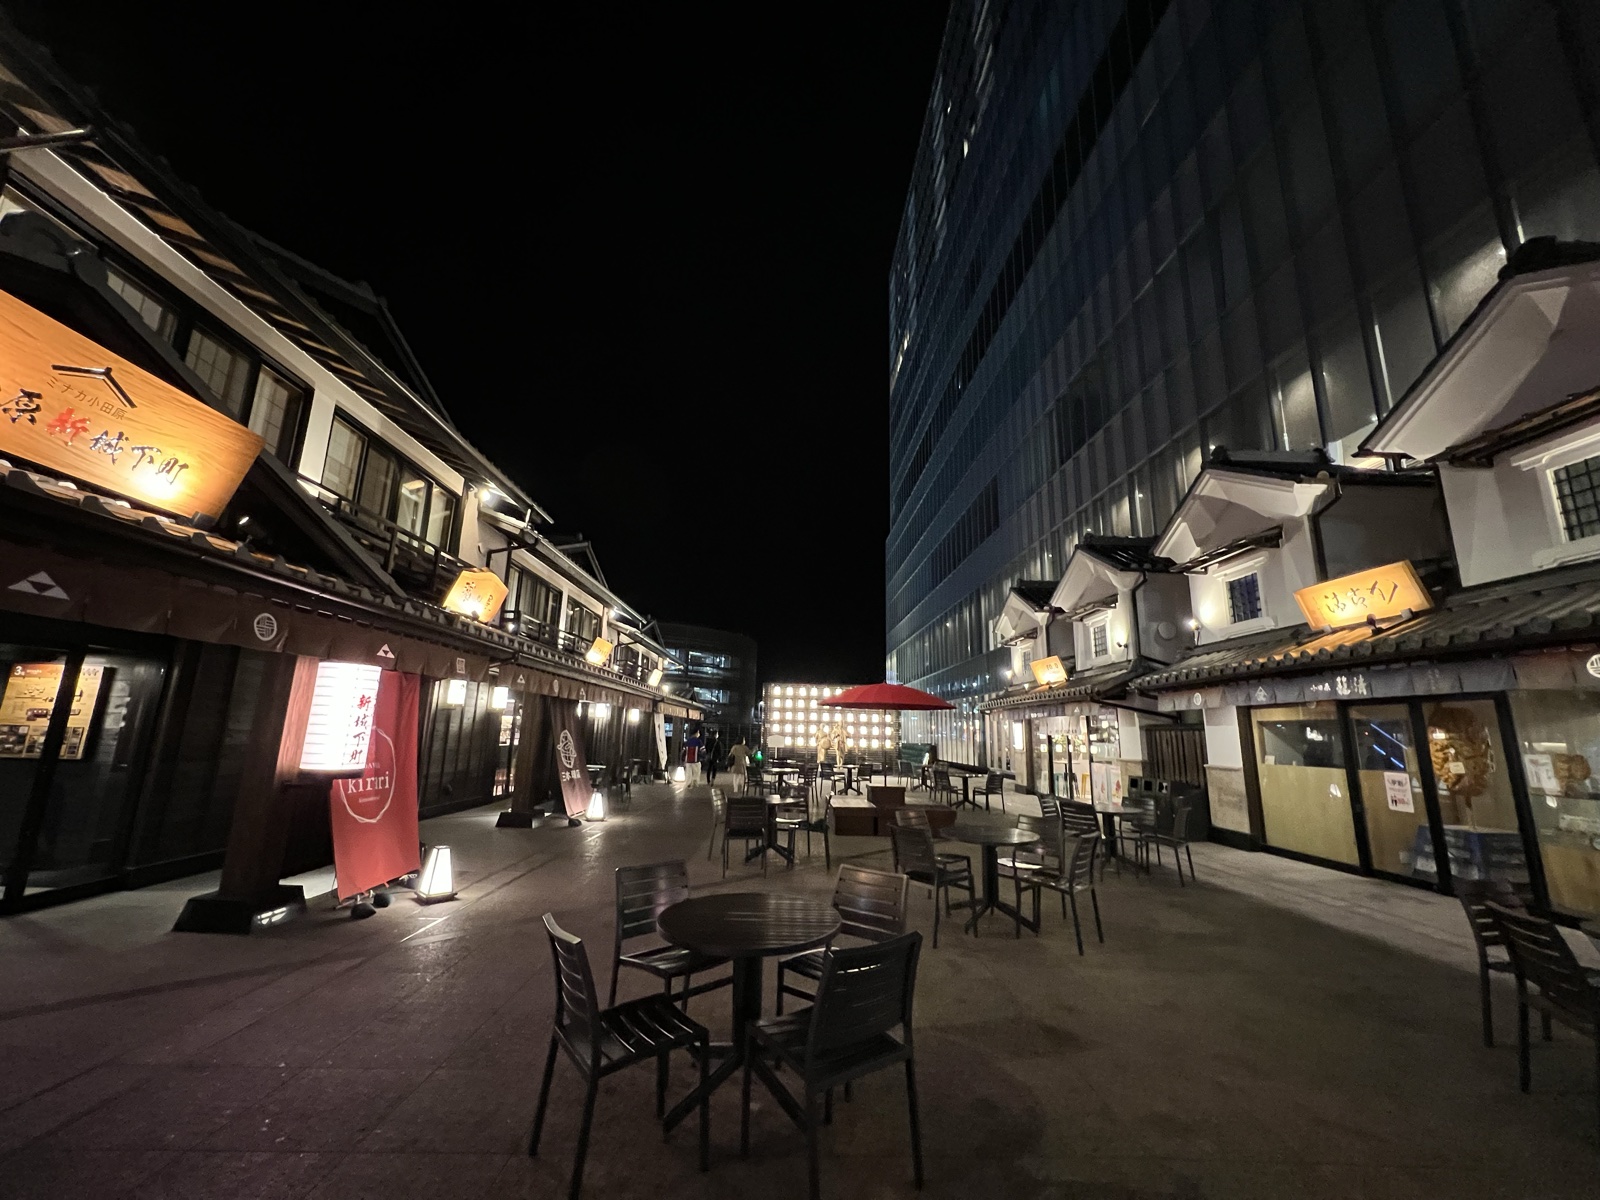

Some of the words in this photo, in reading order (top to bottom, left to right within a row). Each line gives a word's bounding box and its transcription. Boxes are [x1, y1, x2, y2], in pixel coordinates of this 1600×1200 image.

[47, 377, 128, 420] ミナカ小田原
[348, 693, 372, 766] 新城下町
